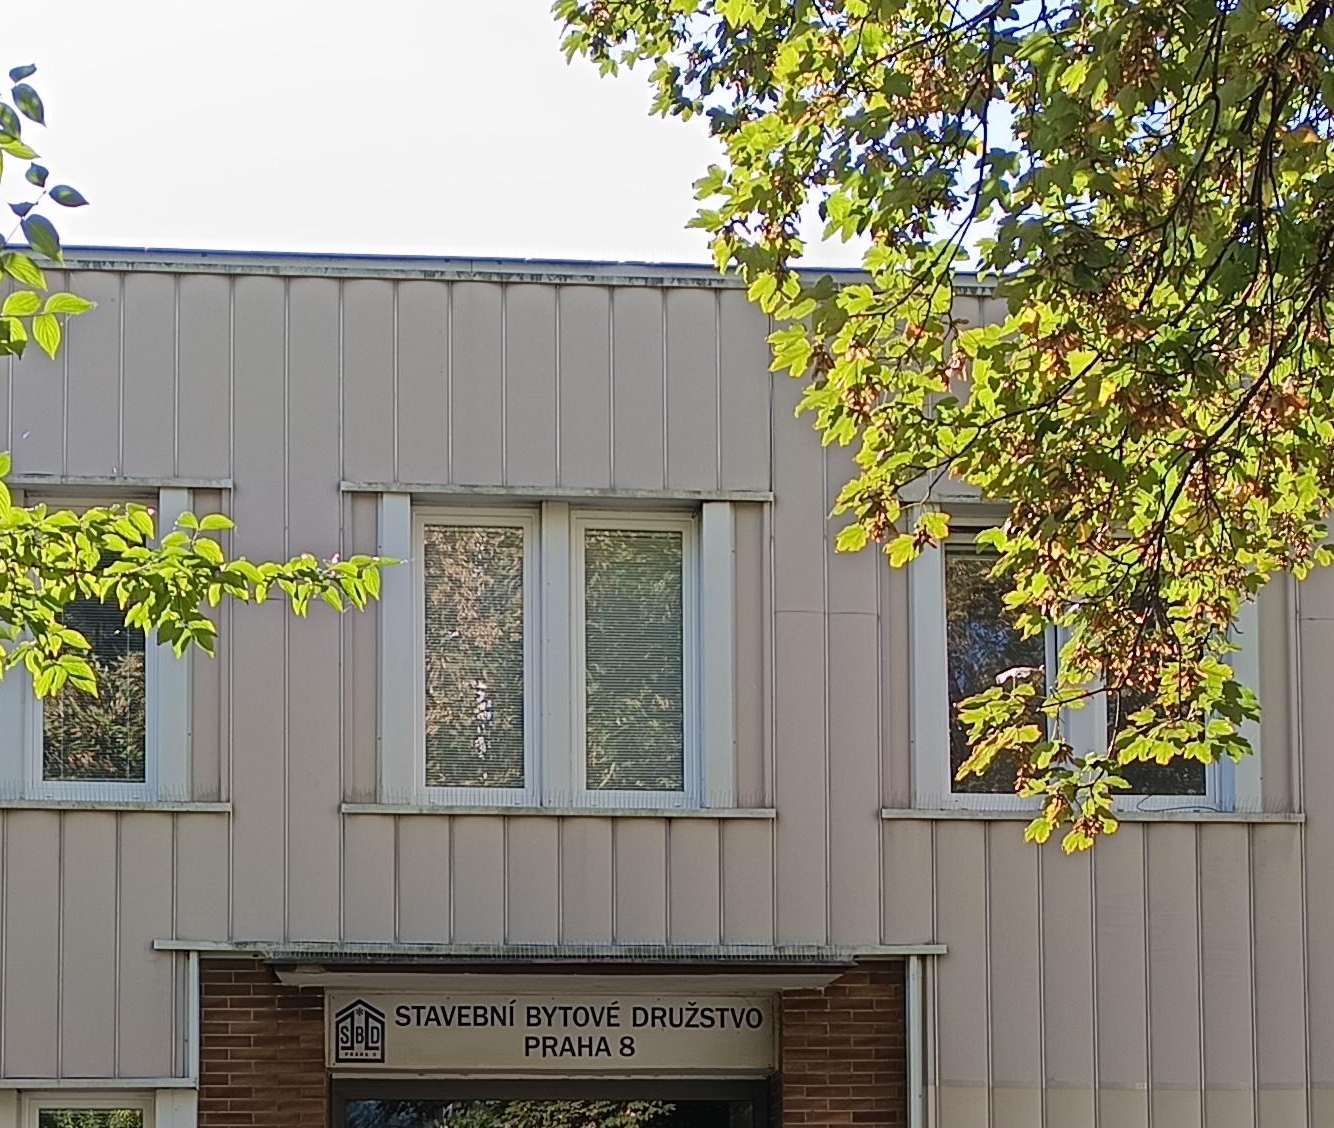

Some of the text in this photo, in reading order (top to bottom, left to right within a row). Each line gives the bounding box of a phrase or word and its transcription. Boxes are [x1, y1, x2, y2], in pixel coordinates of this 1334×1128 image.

[395, 999, 763, 1029] STAVEBNÍ BYTOVÉ DRUŽSTVO
[524, 1036, 636, 1058] PRAHA 8
